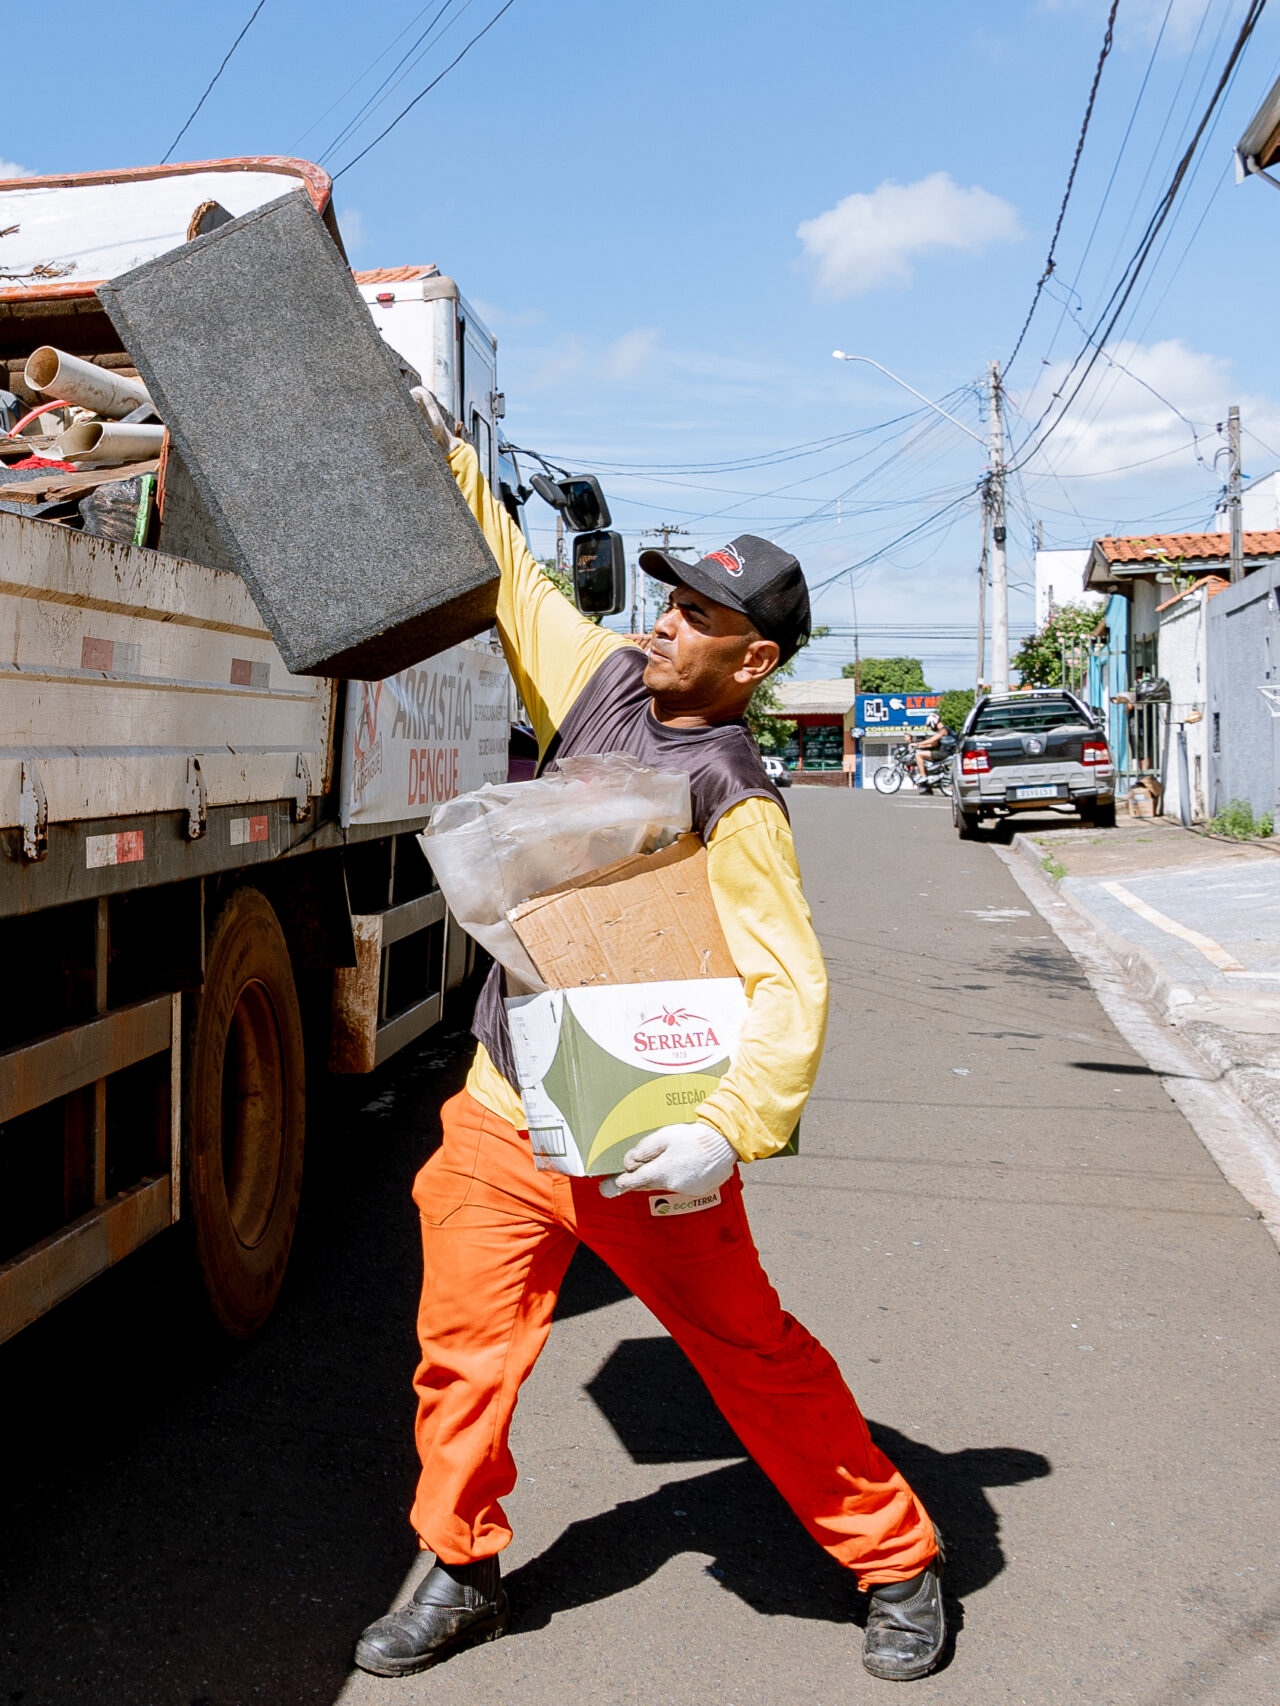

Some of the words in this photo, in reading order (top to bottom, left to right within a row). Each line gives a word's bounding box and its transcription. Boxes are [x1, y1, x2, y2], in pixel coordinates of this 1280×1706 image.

[407, 747, 459, 806] DENGUE
[633, 1027, 721, 1052] SERRATA
[665, 1088, 706, 1107] SELEÇÃO
